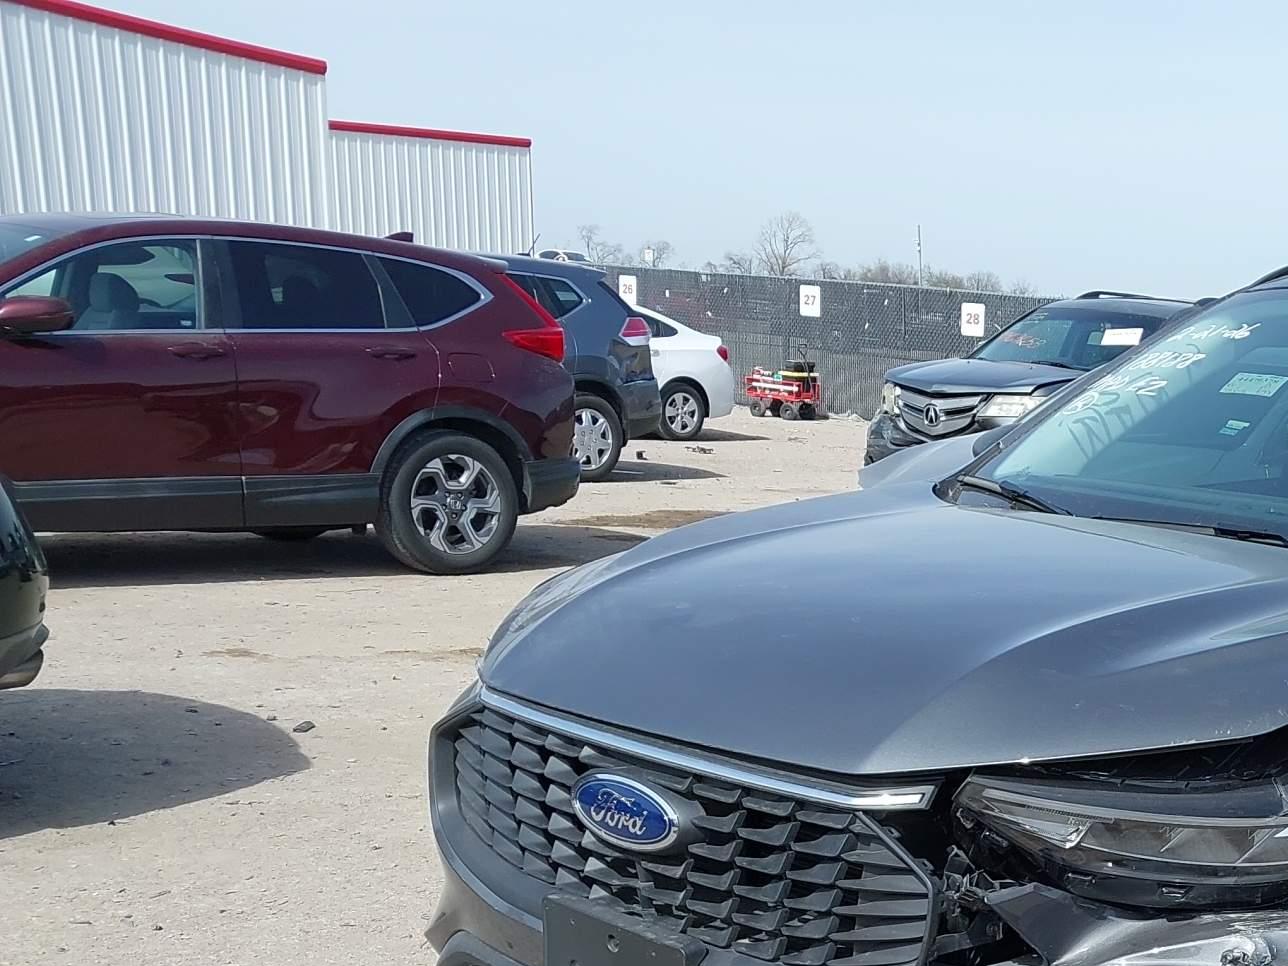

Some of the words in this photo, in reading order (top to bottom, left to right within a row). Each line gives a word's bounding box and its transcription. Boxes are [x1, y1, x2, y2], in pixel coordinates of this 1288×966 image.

[622, 284, 633, 294] 26
[803, 294, 817, 306] 27
[965, 312, 981, 325] 28
[589, 787, 648, 836] Ford
